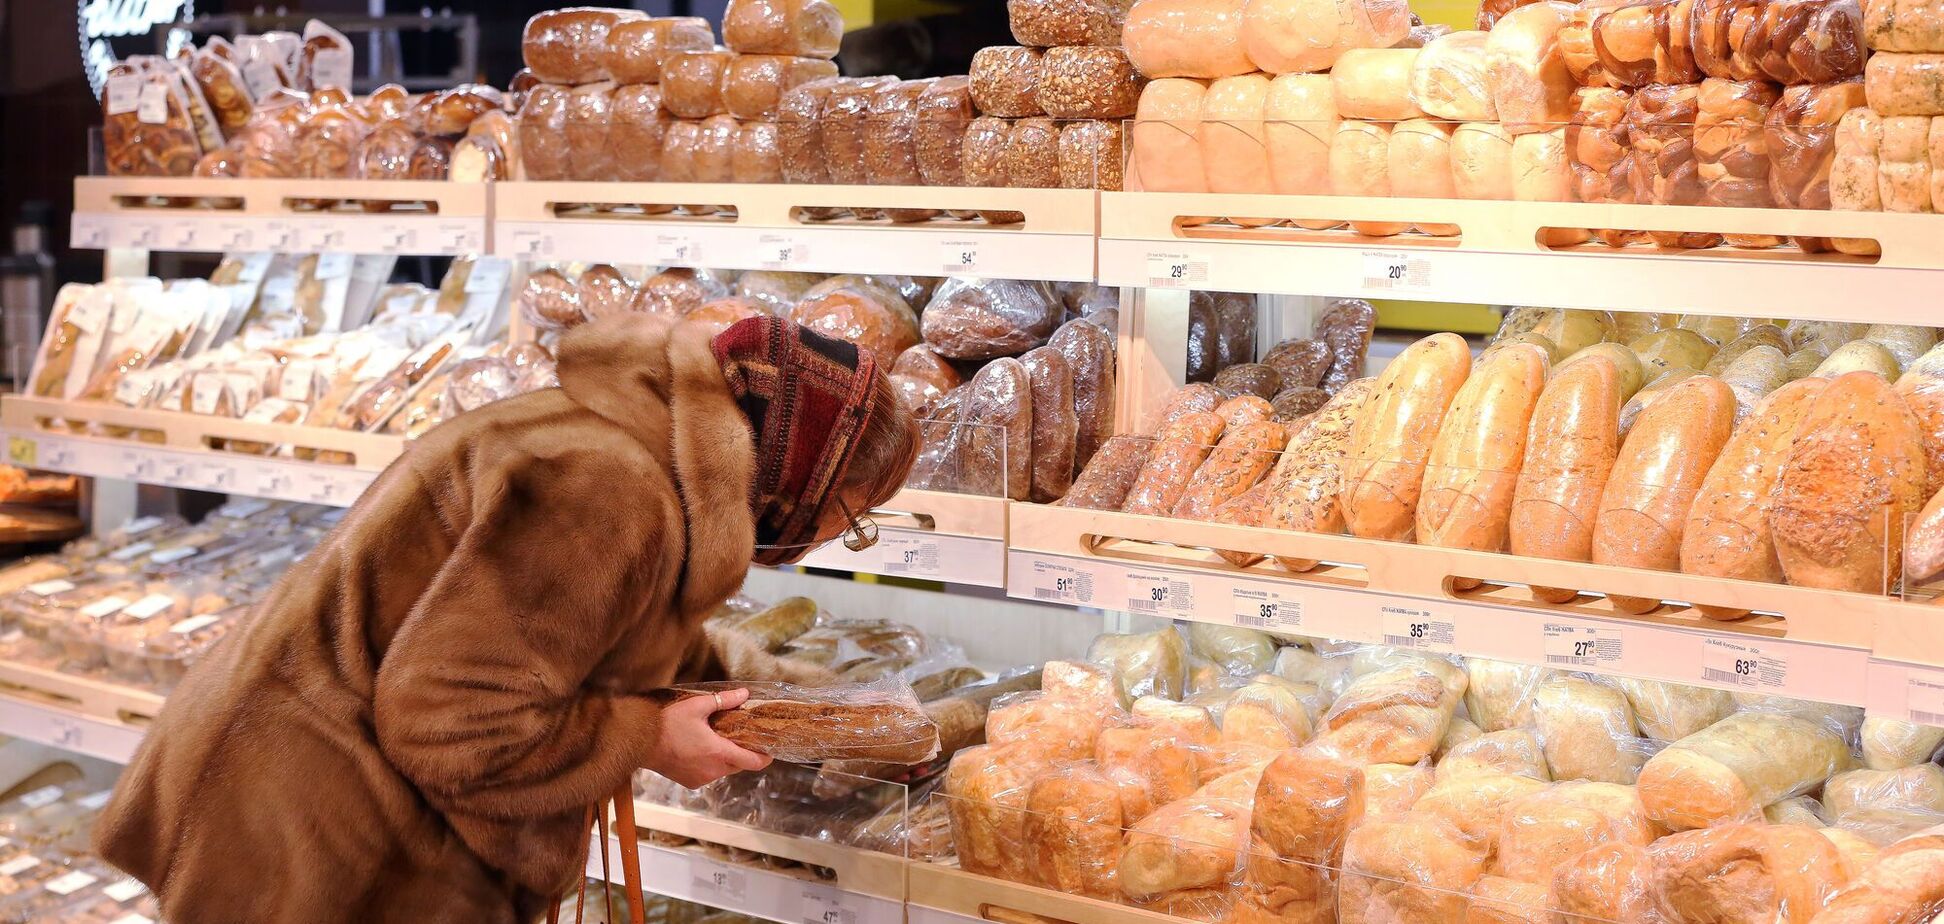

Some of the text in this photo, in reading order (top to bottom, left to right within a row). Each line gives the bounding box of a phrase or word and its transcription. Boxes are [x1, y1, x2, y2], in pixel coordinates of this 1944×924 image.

[962, 252, 972, 264] 54
[1171, 265, 1182, 278] 29
[1388, 265, 1401, 279] 20
[904, 550, 914, 563] 37
[1056, 578, 1067, 591] 51
[1152, 588, 1163, 601] 30
[1260, 604, 1272, 618] 35
[1410, 623, 1423, 637] 35
[1423, 622, 1430, 630] 90
[1574, 642, 1588, 656] 27
[1588, 640, 1594, 648] 90
[1736, 659, 1757, 675] 63 90
[822, 910, 833, 923] 47
